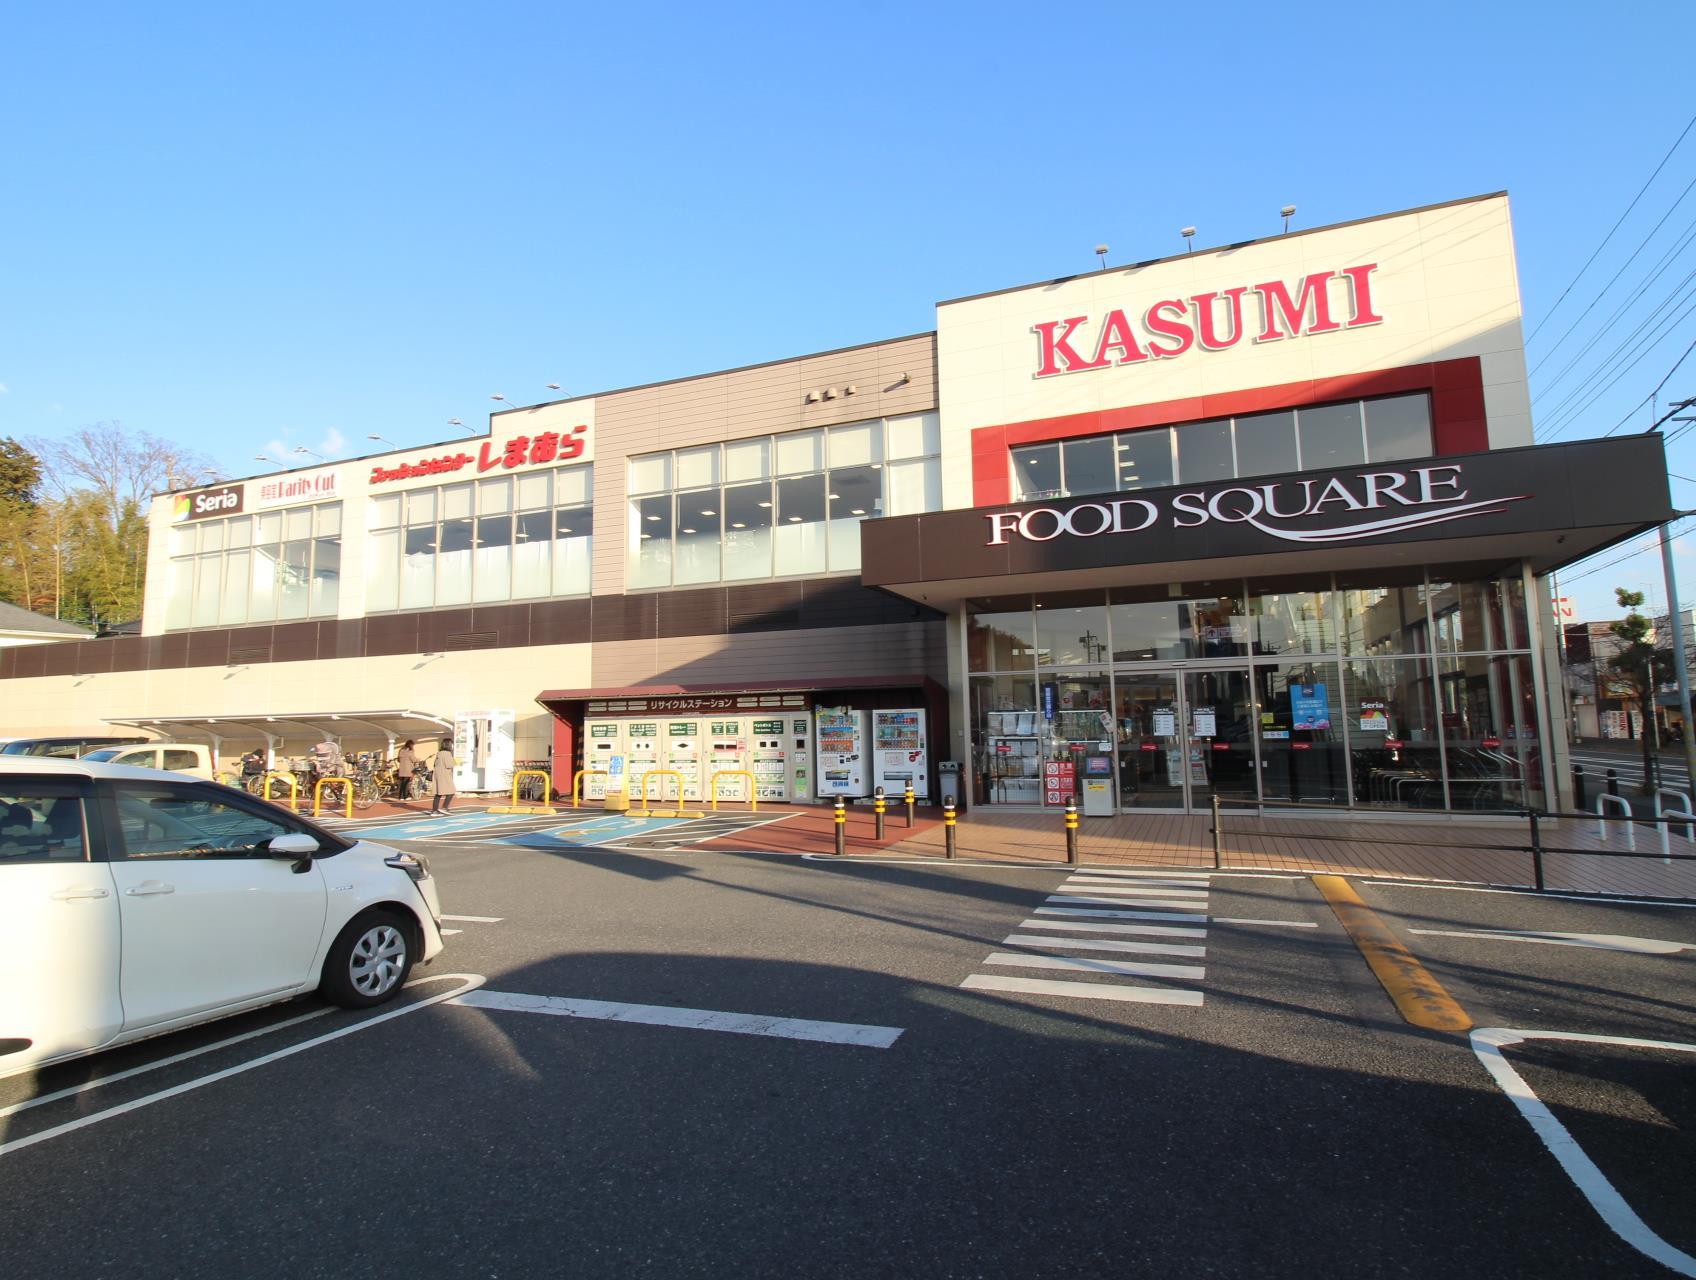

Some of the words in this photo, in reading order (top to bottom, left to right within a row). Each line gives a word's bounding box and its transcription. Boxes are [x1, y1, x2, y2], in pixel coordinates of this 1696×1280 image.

[1033, 263, 1382, 378] KASUMI
[477, 426, 588, 473] しまむら
[314, 473, 335, 491] Cut
[195, 489, 238, 513] Seria
[985, 499, 1158, 546] FOOD
[1173, 465, 1468, 538] SQUARE
[651, 699, 732, 710] リサイクルステーション
[1360, 701, 1384, 709] Seria
